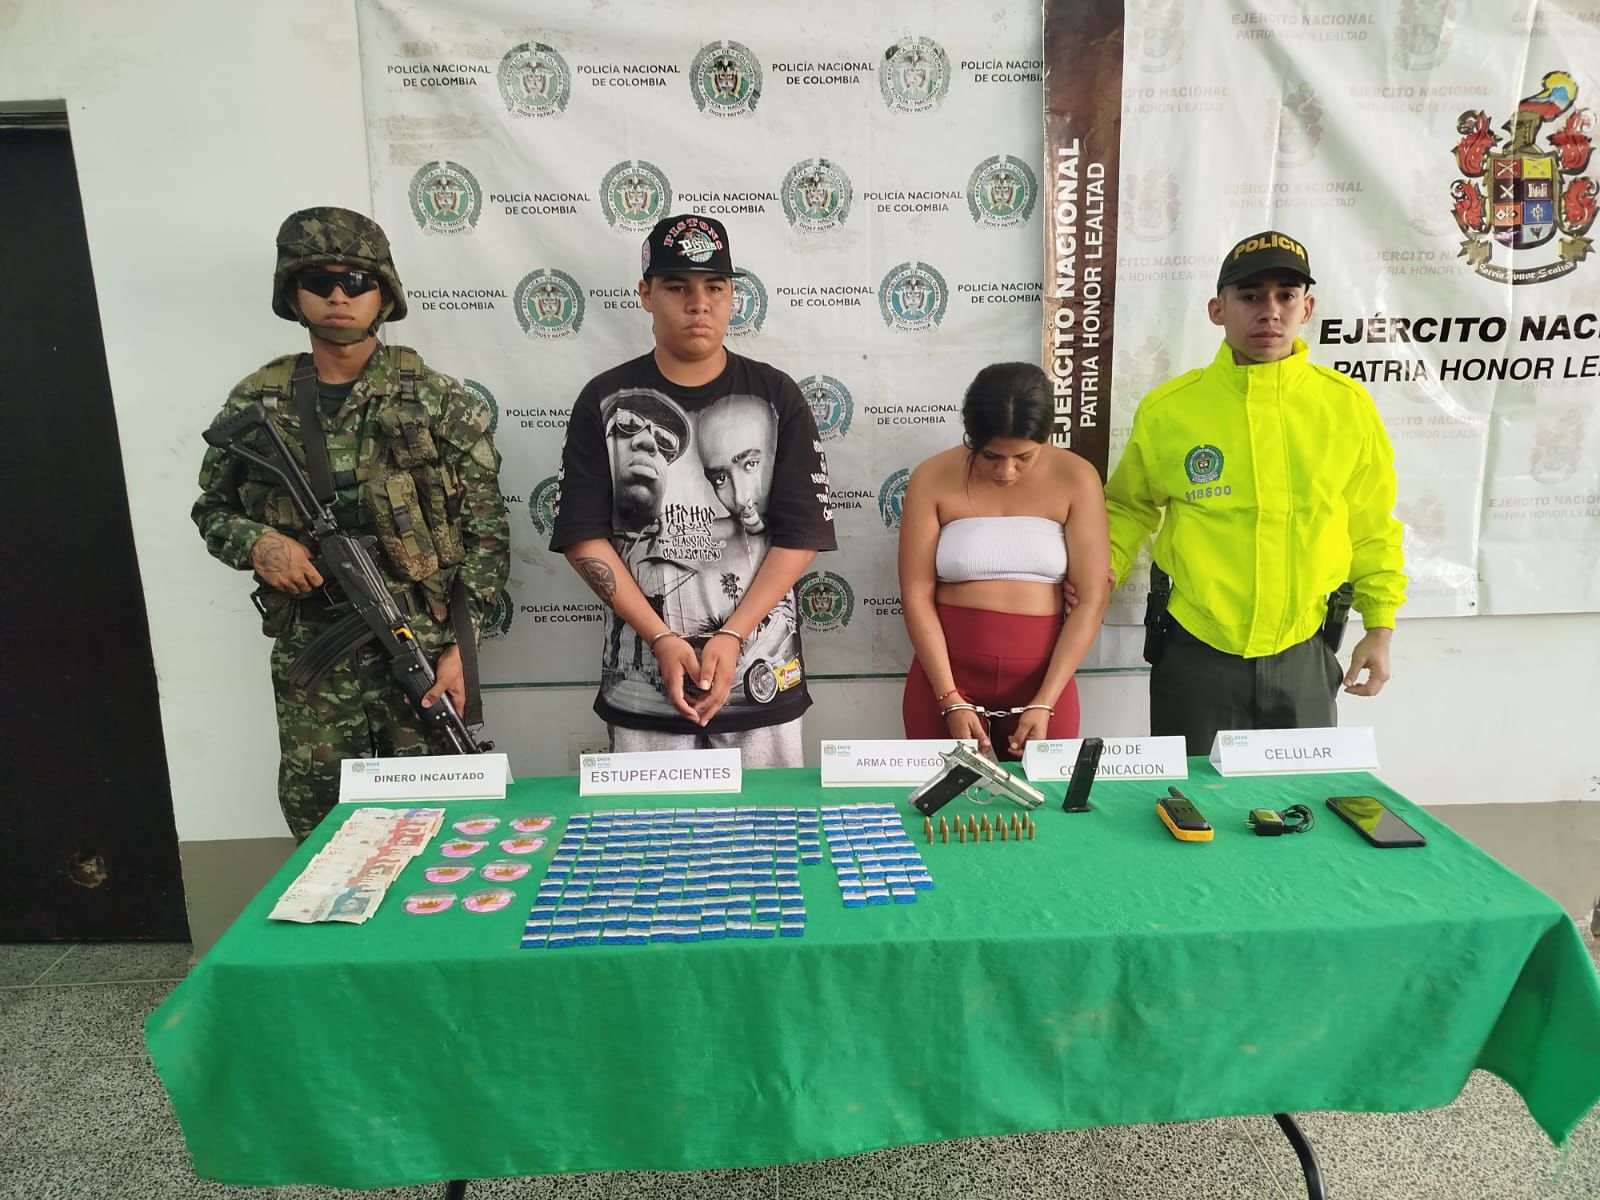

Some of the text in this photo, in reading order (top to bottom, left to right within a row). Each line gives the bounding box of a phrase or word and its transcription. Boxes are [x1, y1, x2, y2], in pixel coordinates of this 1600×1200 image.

[387, 62, 492, 74] POLICÍA NACIONAL
[577, 63, 681, 75] POLICÍA NACIONAL
[772, 61, 875, 73] POLICÍA NACIONAL
[961, 58, 1043, 70] POLICÍA NACIO
[403, 77, 477, 88] DE COLOMBIA
[592, 77, 667, 87] DE COLOMBIA
[786, 75, 860, 85] DE COLOMBIA
[974, 74, 988, 83] DE
[489, 191, 591, 203] POLICÍA NACIONAL
[678, 191, 779, 202] POLICÍA NACIONAL
[863, 191, 963, 201] POLICÍA NACIONAL
[505, 205, 578, 215] DE COLOMBIA
[692, 205, 766, 214] DE COLOMBIA
[877, 203, 949, 213] DE COLOMBIA
[1056, 138, 1079, 298] NACIONAL
[1118, 256, 1149, 268] CITO
[407, 287, 508, 299] POLICÍA NACIONAL
[589, 286, 632, 298] POLICÍA
[776, 285, 875, 296] POLICÍA NACIONAL
[957, 282, 1043, 293] POLICÍA NACION
[971, 294, 1041, 304] DE COLOMBIA
[1080, 162, 1104, 427] PATRIA HONOR LEALTAD
[422, 301, 495, 311] DE COLOMBIA
[603, 300, 618, 310] DE
[790, 298, 861, 308] DE COLOMBIA
[1319, 312, 1600, 345] EJÉRCITO NAC
[1334, 355, 1600, 382] PATRIA HONOR LE
[506, 407, 547, 417] POLICÍA
[864, 404, 960, 415] POLICÍA NACIONAL
[520, 420, 569, 429] DE COLO
[877, 415, 946, 426] DE COLOMBIA
[830, 489, 875, 499] ACIONAL
[830, 500, 862, 510] OMBIA
[690, 505, 716, 525] HOP
[863, 595, 902, 606] POLICÍA
[520, 602, 603, 613] POLICÍA NACION
[876, 608, 889, 617] DE
[534, 614, 603, 624] DE COLOMBIA
[1101, 744, 1142, 756] DIO DE
[1264, 747, 1332, 760] CELULAR
[856, 758, 944, 768] ARMA DE FUEGO
[374, 772, 485, 783] DINERO INCAUTADO
[591, 767, 731, 783] ESTUPEFACIENTES
